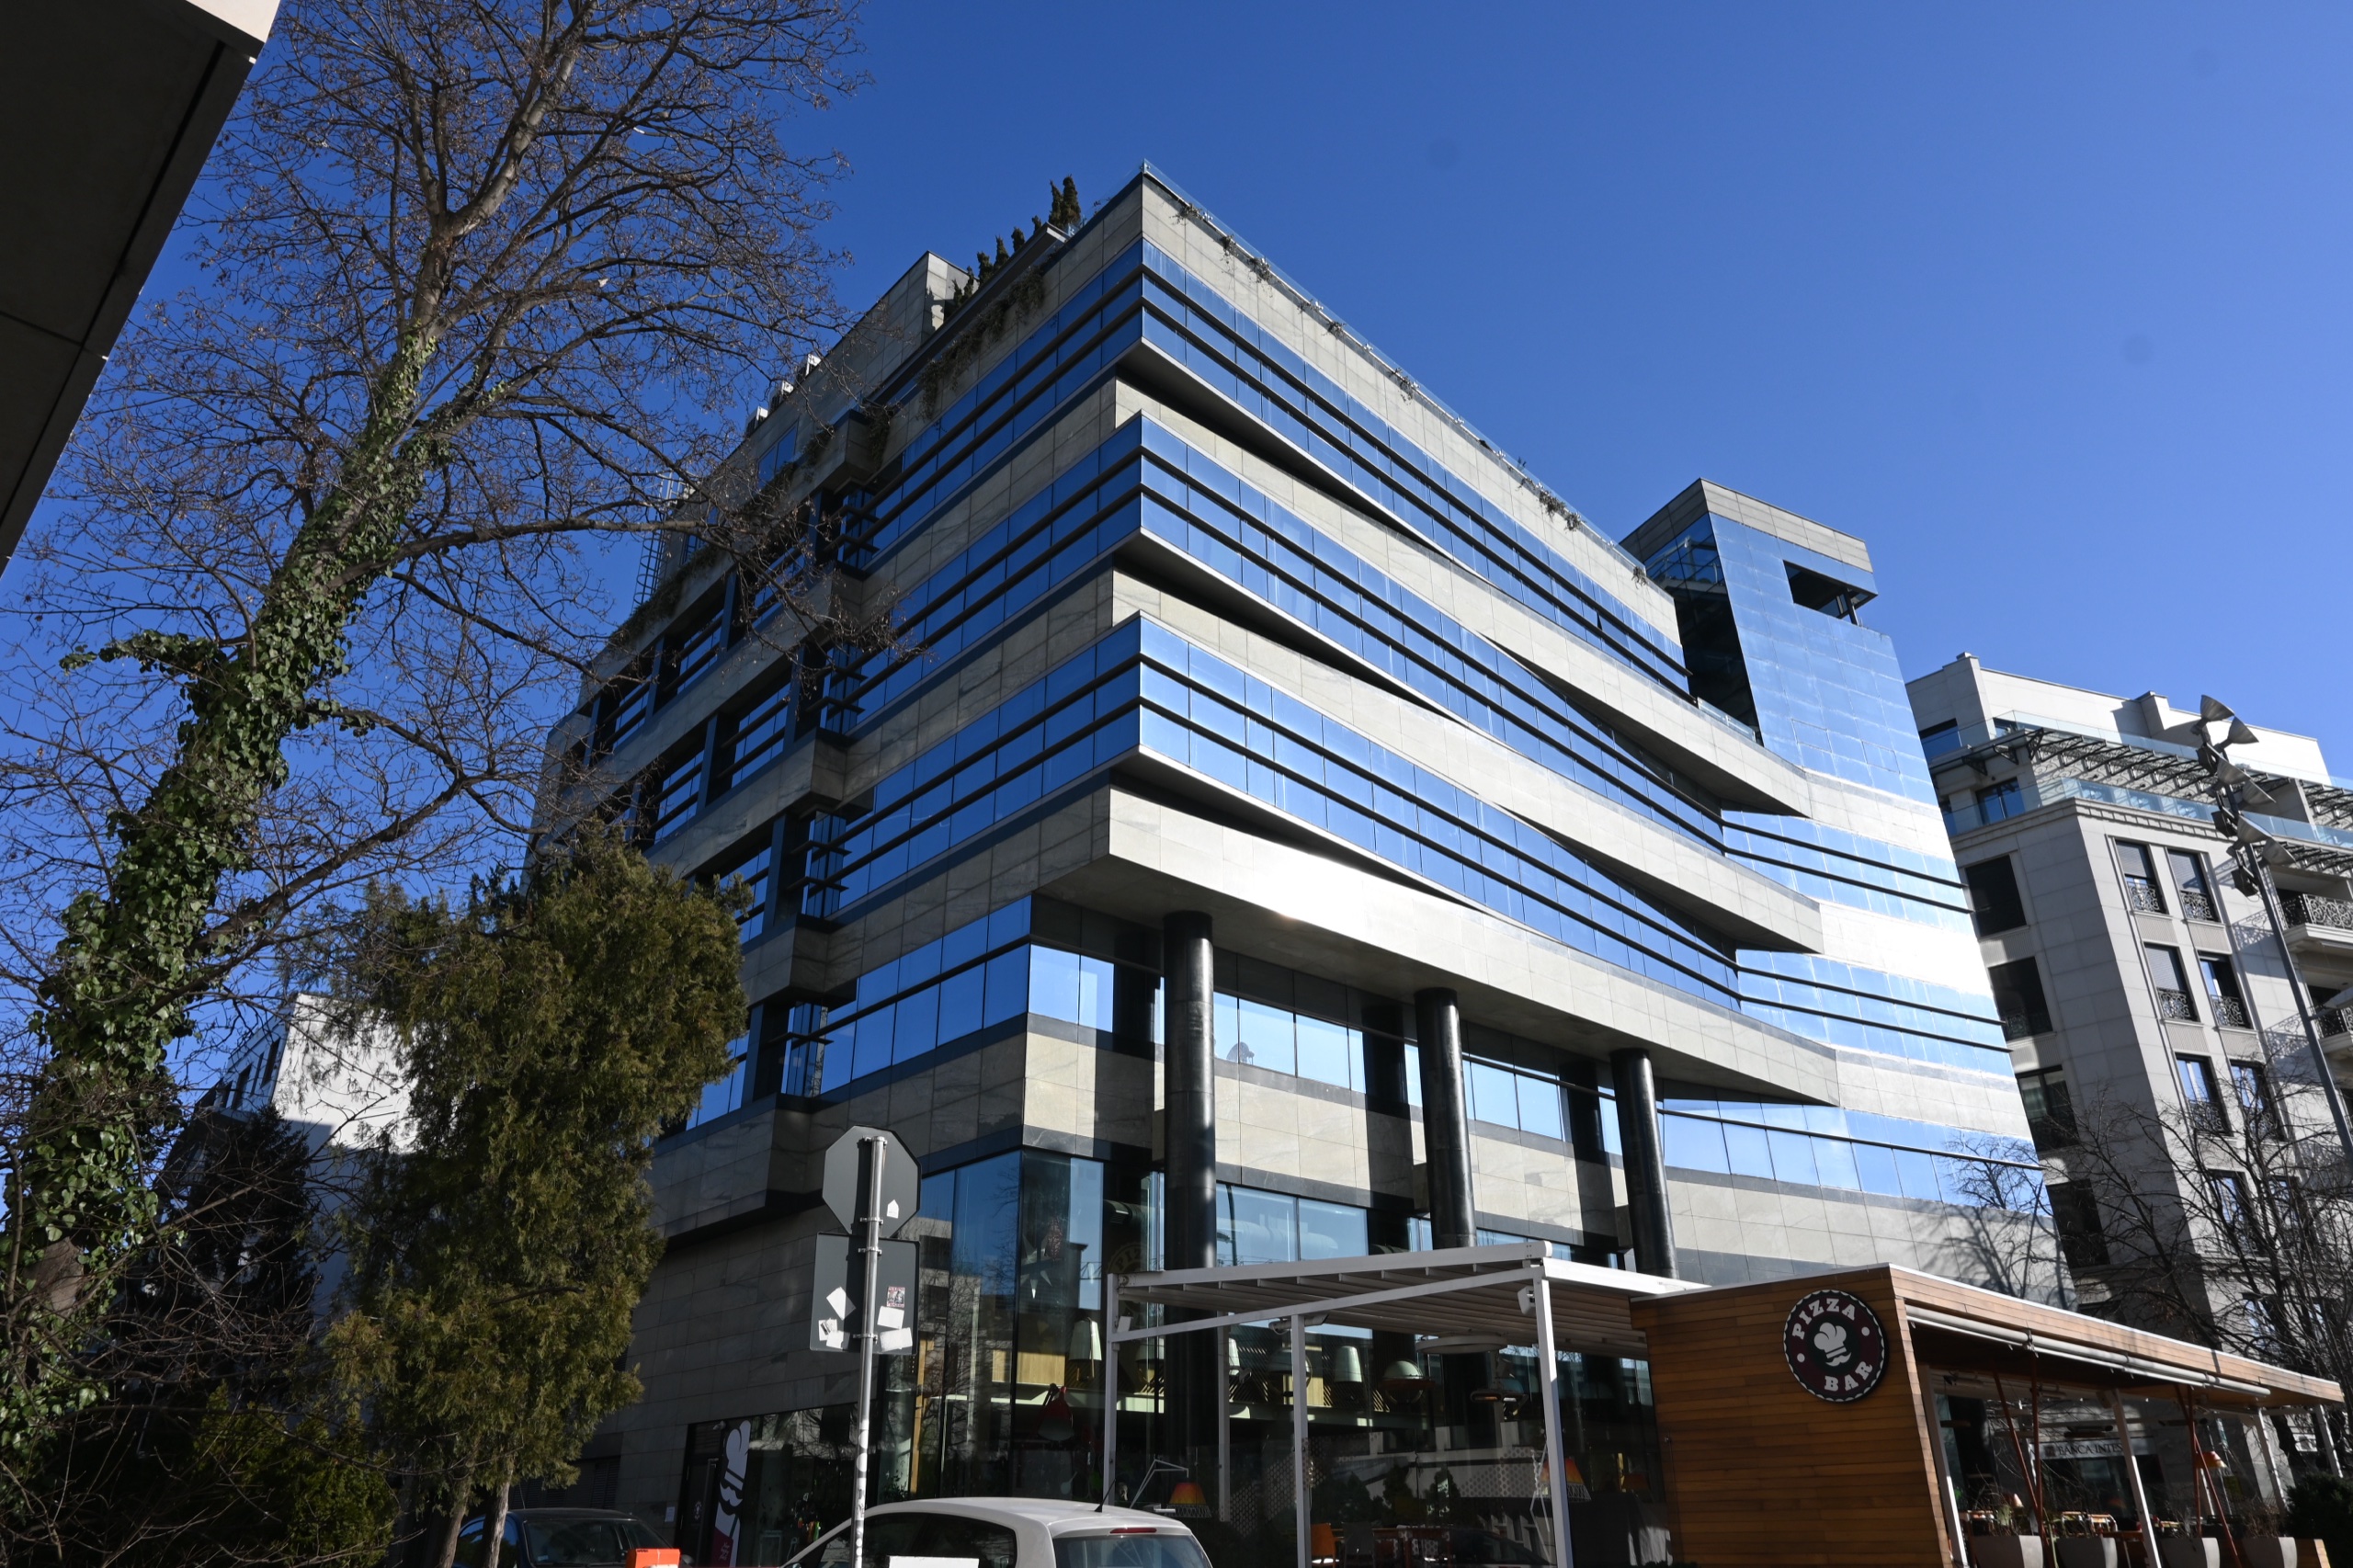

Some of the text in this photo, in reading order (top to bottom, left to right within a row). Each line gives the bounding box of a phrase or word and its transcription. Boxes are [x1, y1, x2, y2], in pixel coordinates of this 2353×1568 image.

[1791, 1298, 1856, 1340] PIZZA
[1824, 1360, 1873, 1392] BAR
[2057, 1442, 2123, 1455] BANCA INTES
